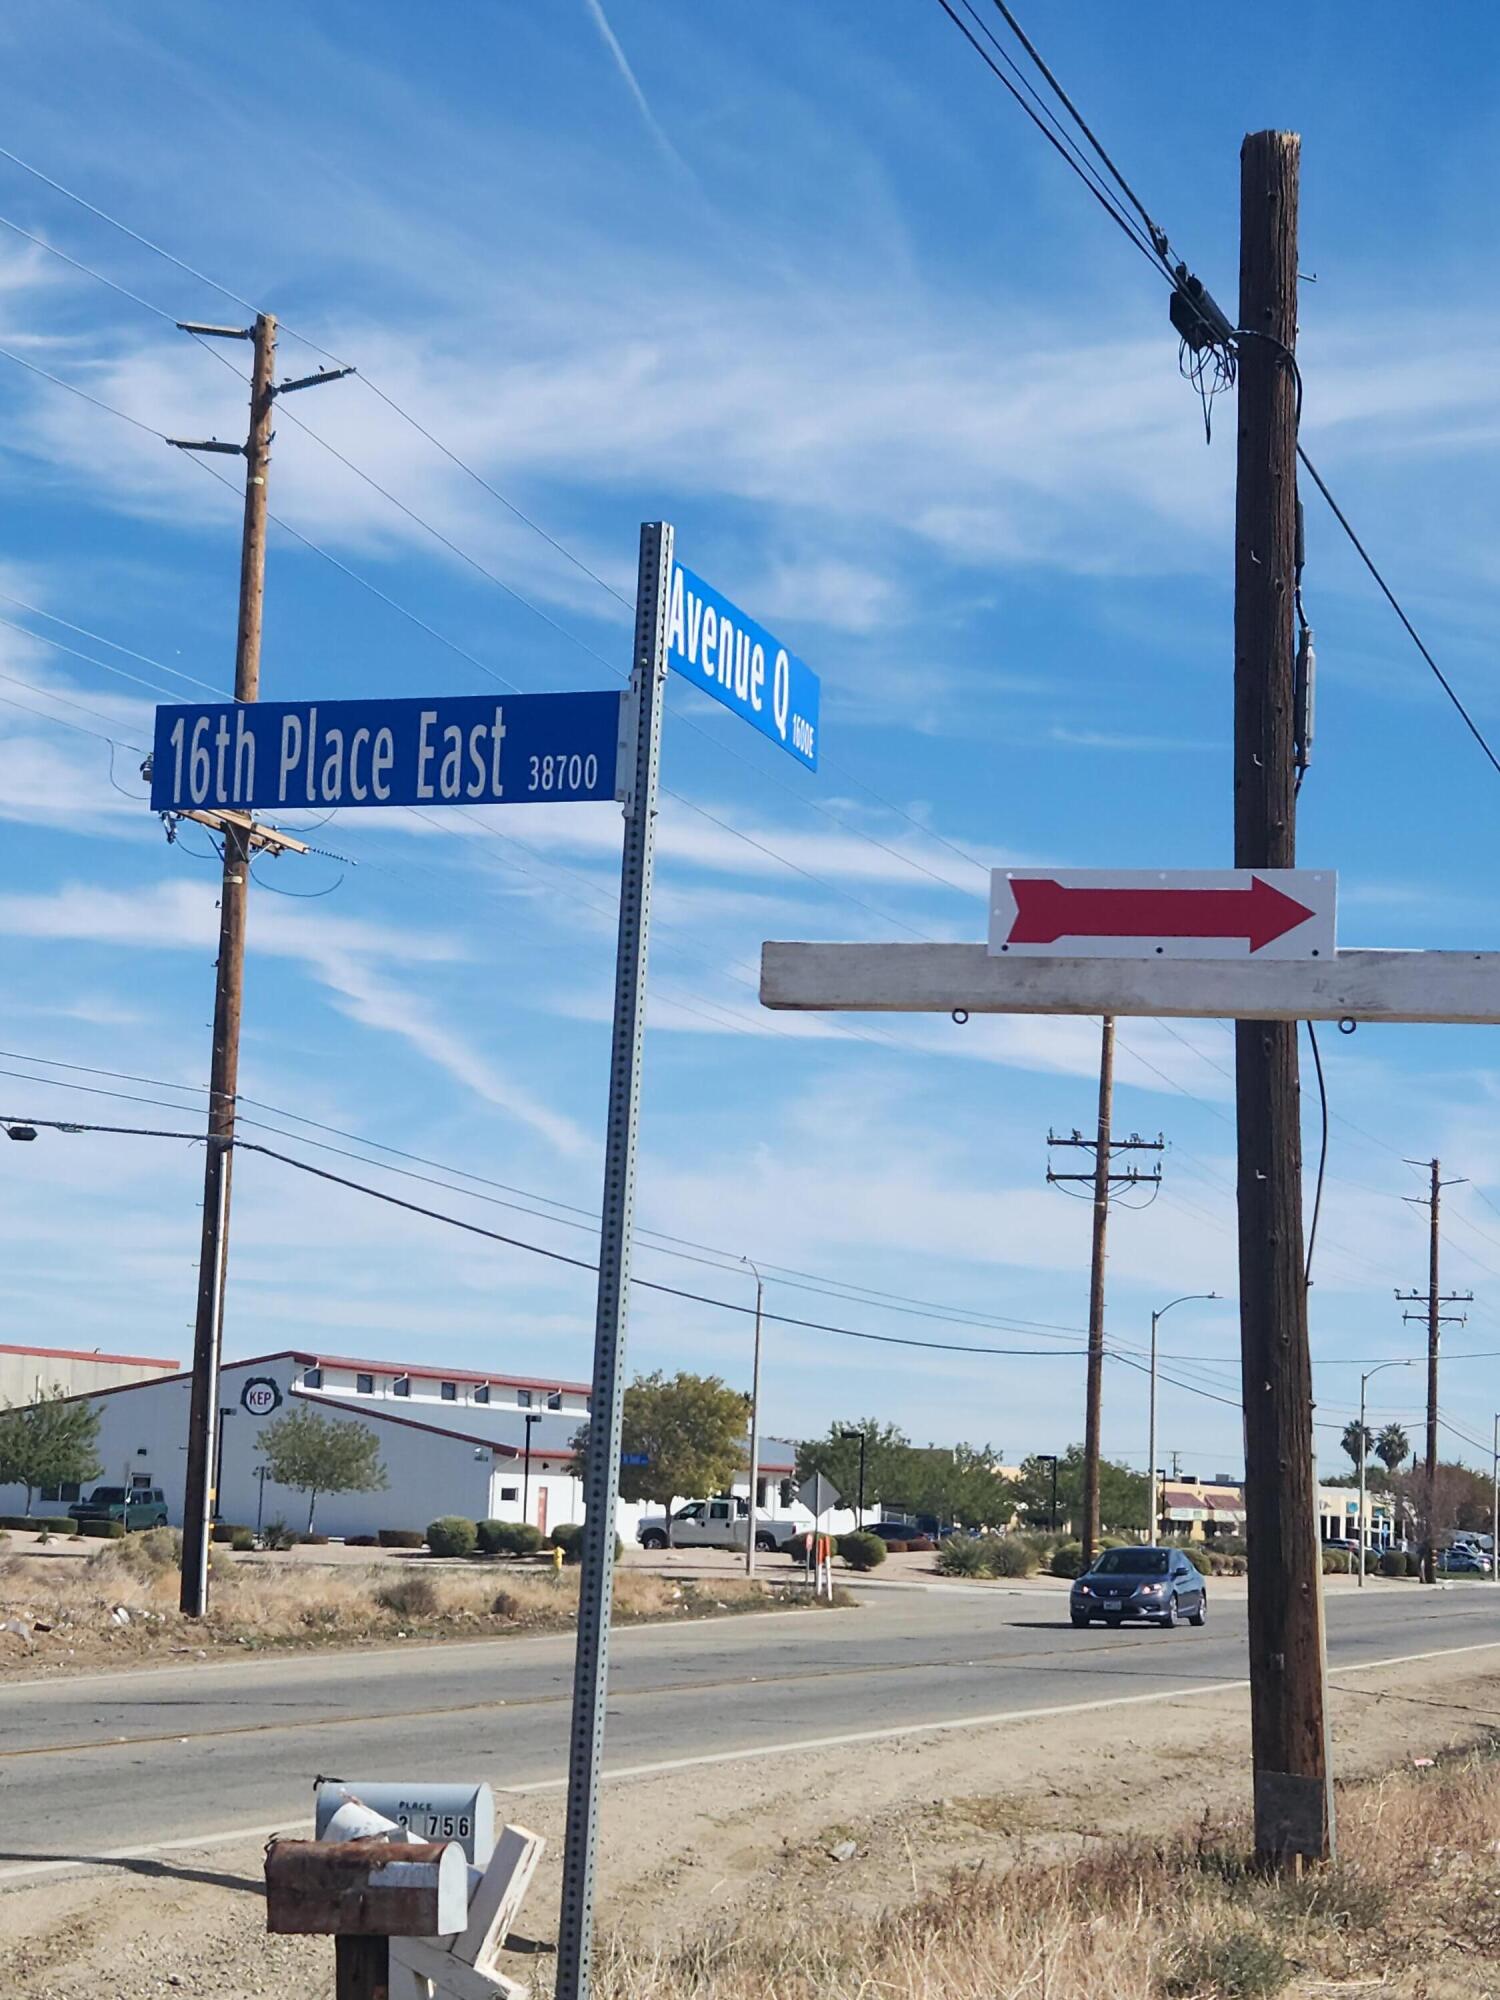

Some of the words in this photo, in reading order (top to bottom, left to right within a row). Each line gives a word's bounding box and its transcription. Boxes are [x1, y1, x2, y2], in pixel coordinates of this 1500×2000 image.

[668, 566, 765, 712] Avenue
[773, 648, 790, 741] Q
[170, 709, 256, 804] 16th
[278, 707, 394, 802] Place
[416, 706, 507, 799] East
[527, 753, 598, 791] 38700
[249, 1391, 272, 1406] KEP
[398, 1800, 433, 1812] PLACE
[428, 1815, 470, 1837] 756
